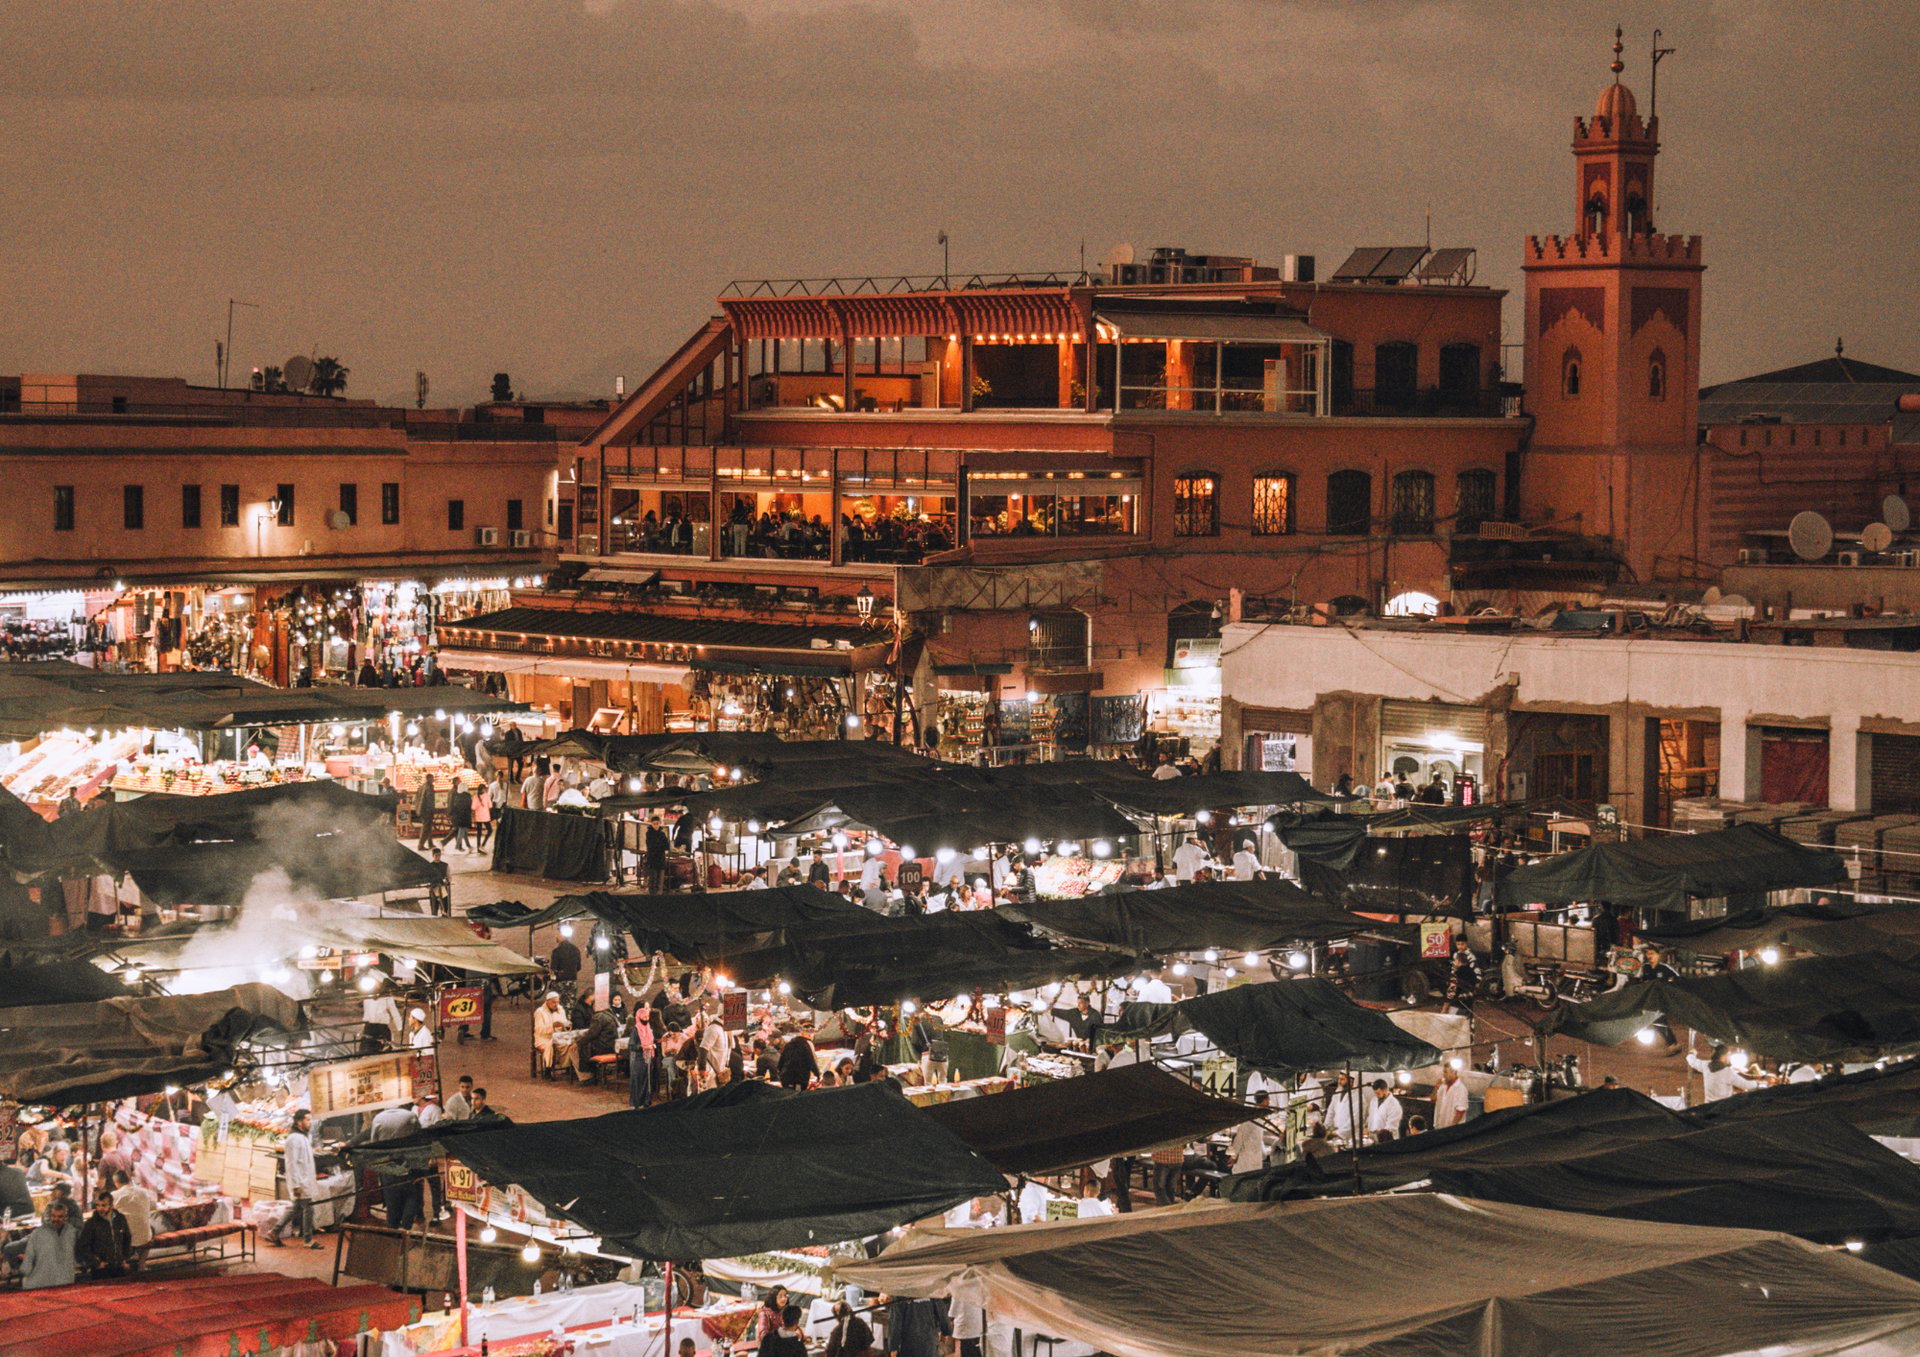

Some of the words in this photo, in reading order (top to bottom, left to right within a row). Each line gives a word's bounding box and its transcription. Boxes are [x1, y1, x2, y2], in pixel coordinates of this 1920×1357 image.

[1597, 811, 1616, 825] 36
[901, 872, 920, 884] 100
[1428, 934, 1443, 946] 50
[318, 946, 331, 957] 31
[1203, 1071, 1236, 1099] 44
